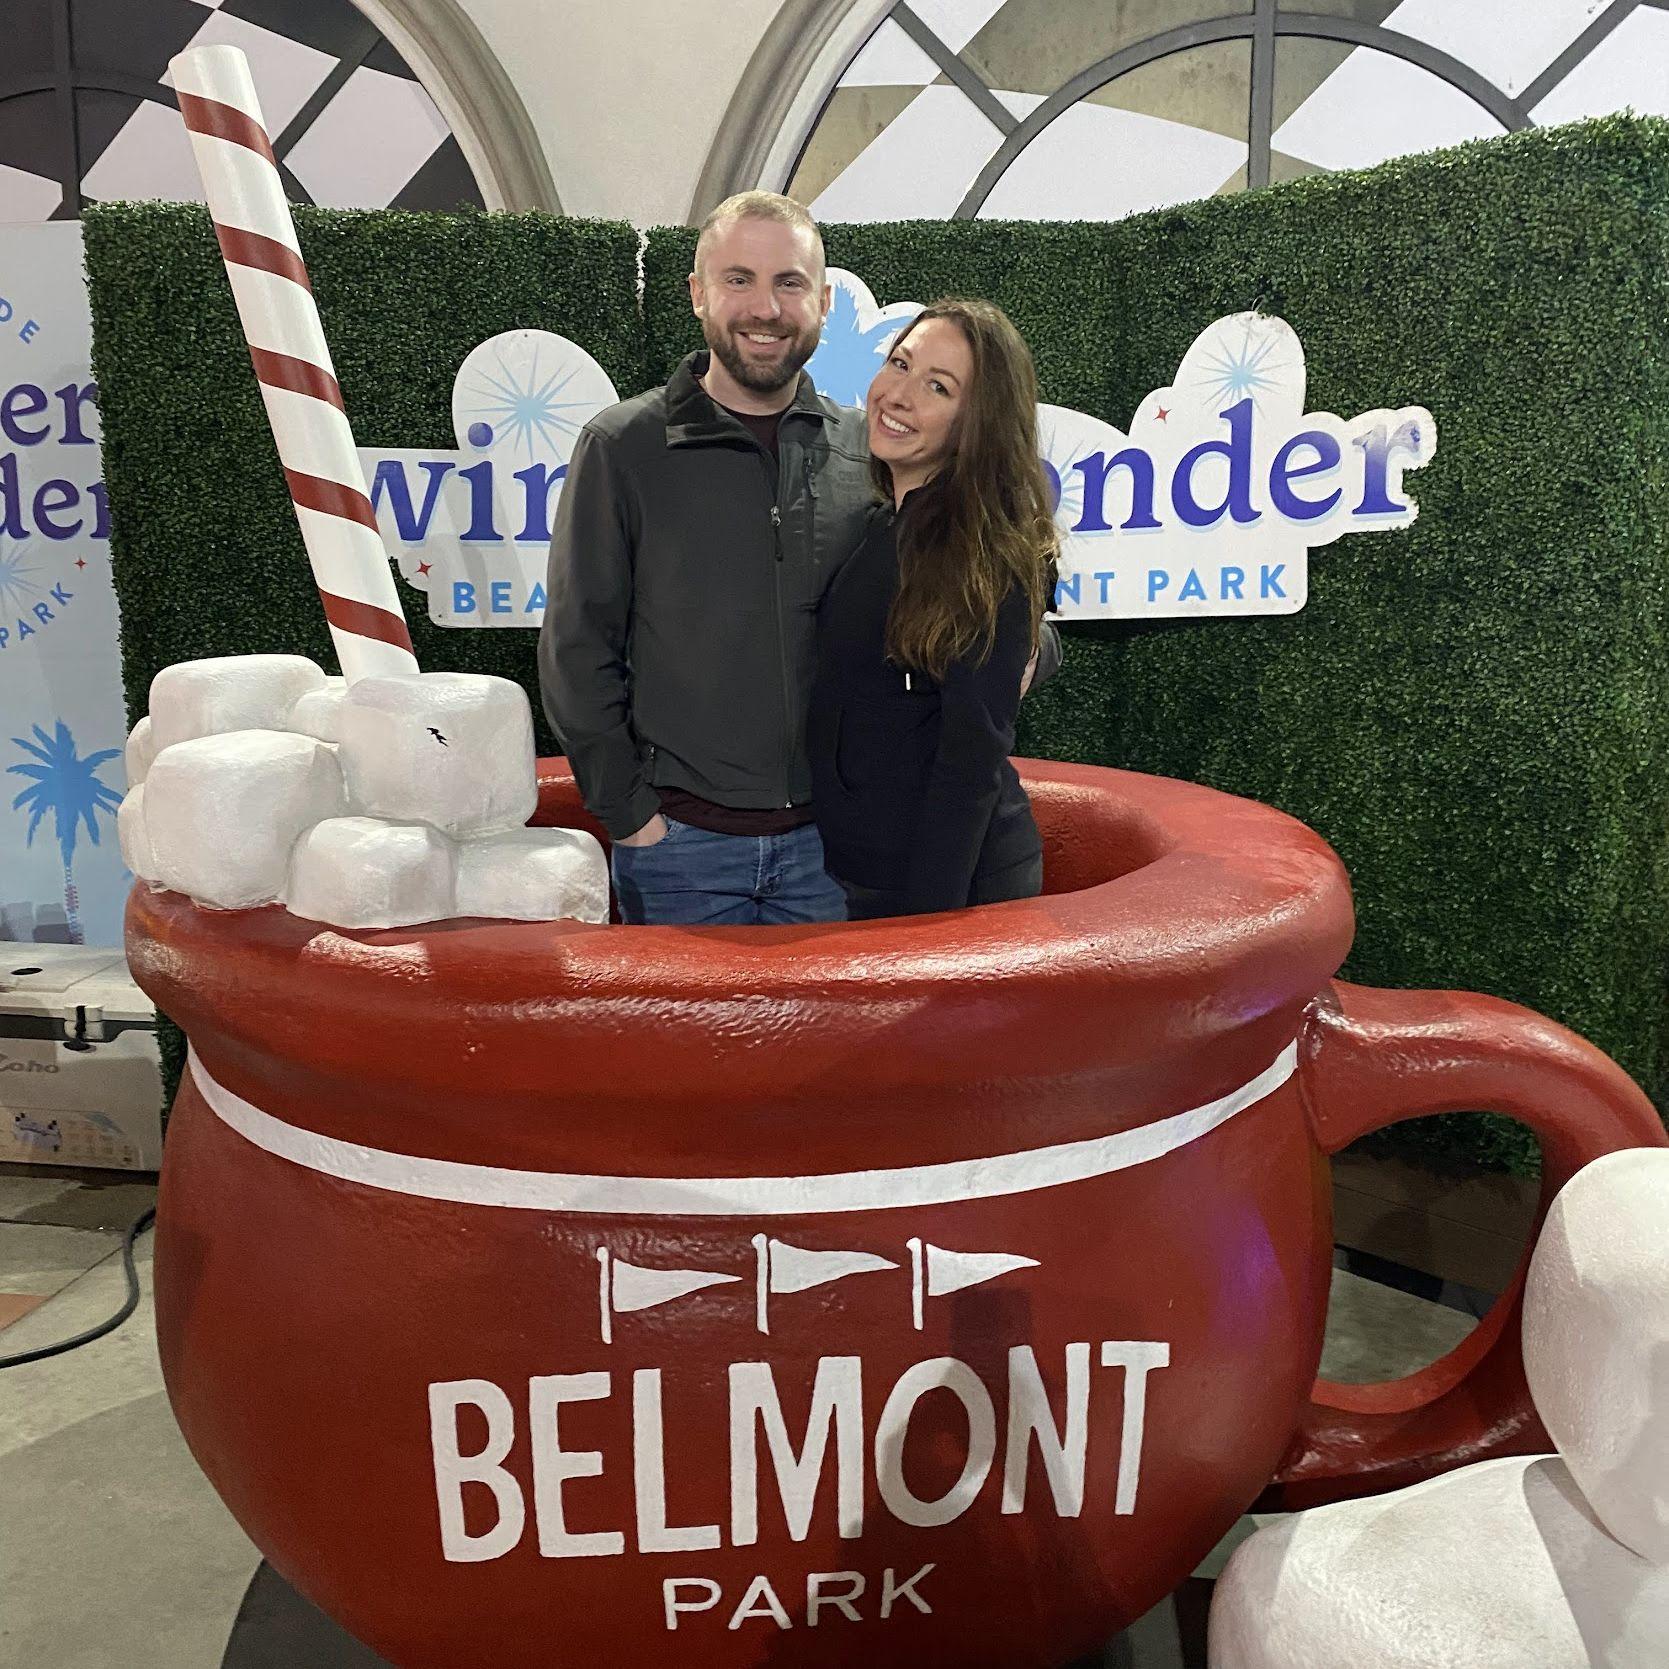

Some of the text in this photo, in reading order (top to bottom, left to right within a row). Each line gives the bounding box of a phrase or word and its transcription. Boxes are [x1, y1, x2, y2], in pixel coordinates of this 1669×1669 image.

[1147, 564, 1287, 602] PARK
[428, 1340, 1170, 1563] BELMONT
[663, 1563, 935, 1630] PARK
